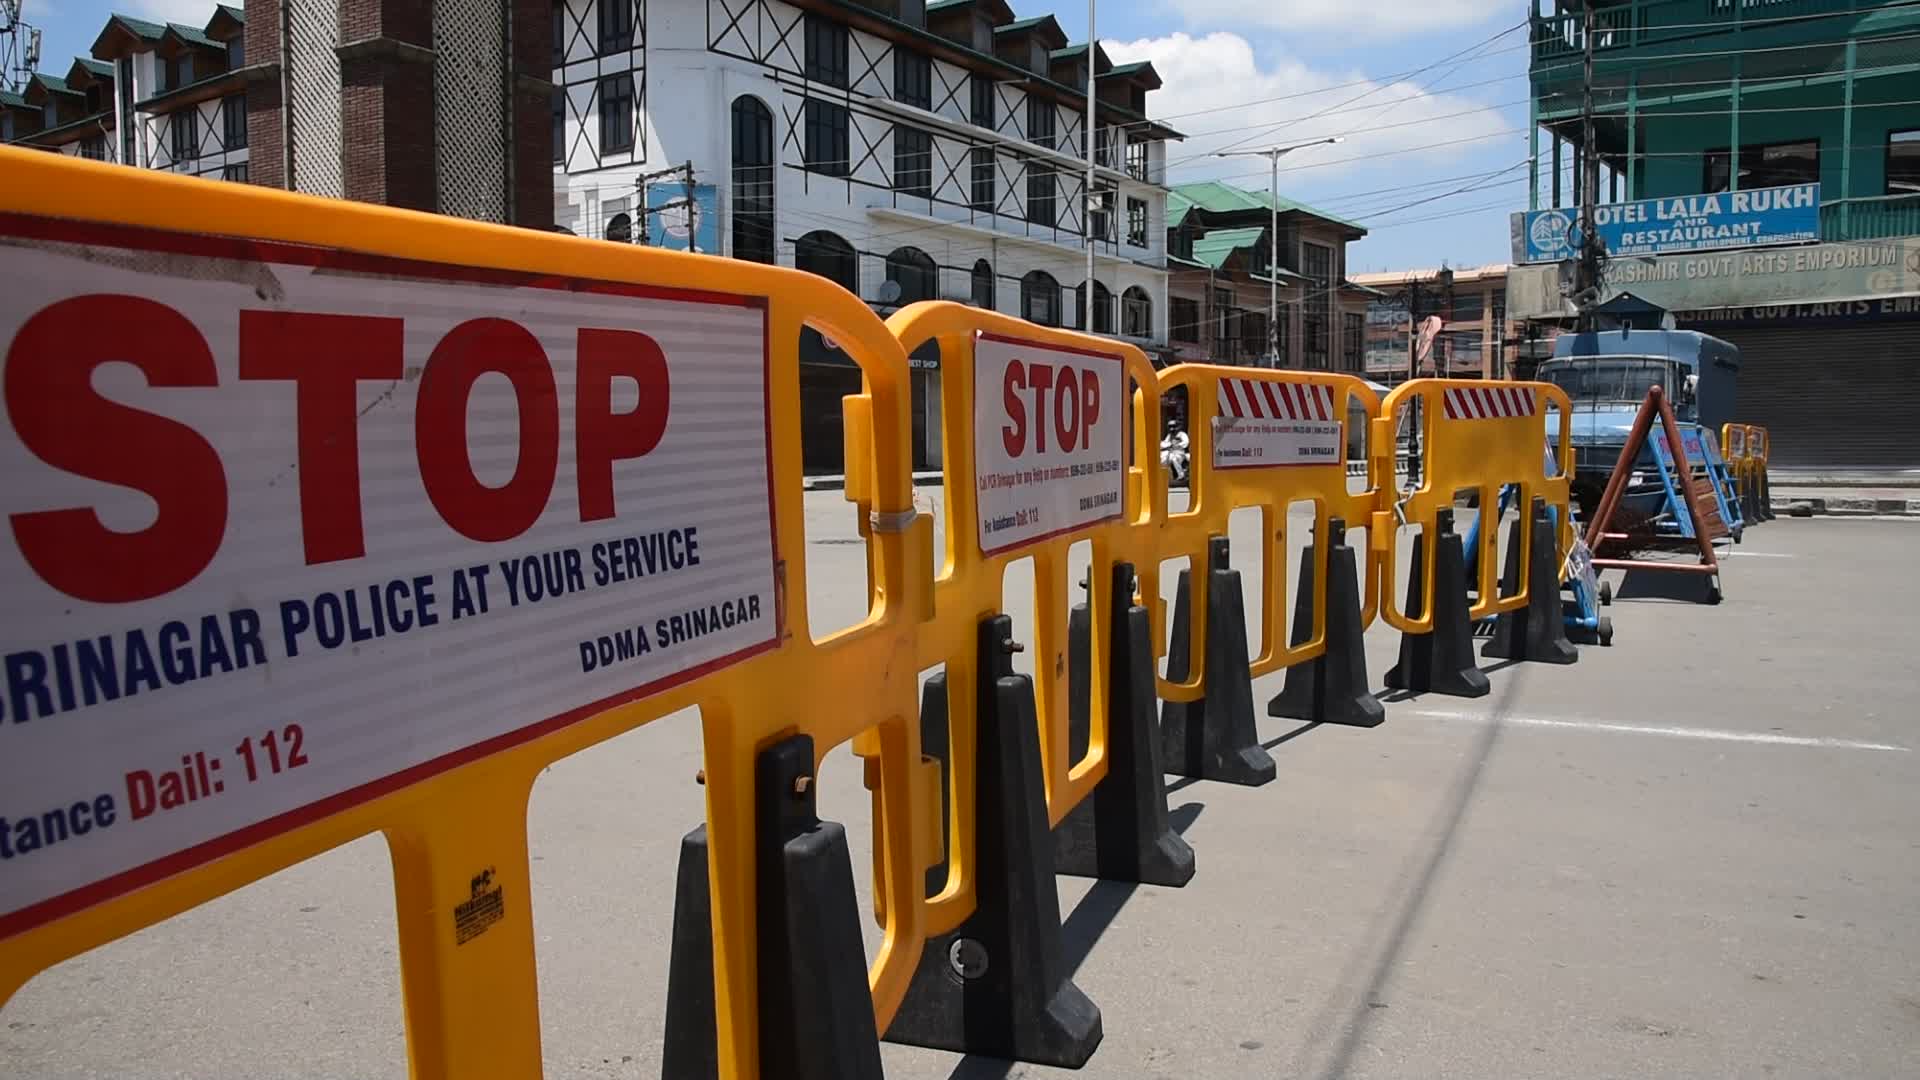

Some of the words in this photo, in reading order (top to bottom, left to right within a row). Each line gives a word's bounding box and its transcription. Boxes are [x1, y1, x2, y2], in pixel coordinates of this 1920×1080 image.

[1621, 222, 1762, 246] RESTAURANT
[1656, 194, 1721, 220] LALA
[1731, 186, 1814, 214] RUKH
[1673, 217, 1708, 228] AND
[1685, 256, 1735, 279] GOVT.
[1741, 253, 1788, 276] ARTS
[1795, 246, 1897, 272] EMPORIUM
[1002, 359, 1100, 458] STOP
[3, 293, 670, 604] STOP
[0, 608, 267, 726] RINAGAR
[280, 575, 438, 658] POLICE
[452, 564, 490, 620] AT
[500, 548, 585, 607] YOUR
[591, 527, 700, 587] SERVICE
[579, 626, 651, 672] DDMA
[656, 594, 761, 648] SRINAGAR
[125, 751, 224, 821] Dail:
[236, 723, 308, 783] 112
